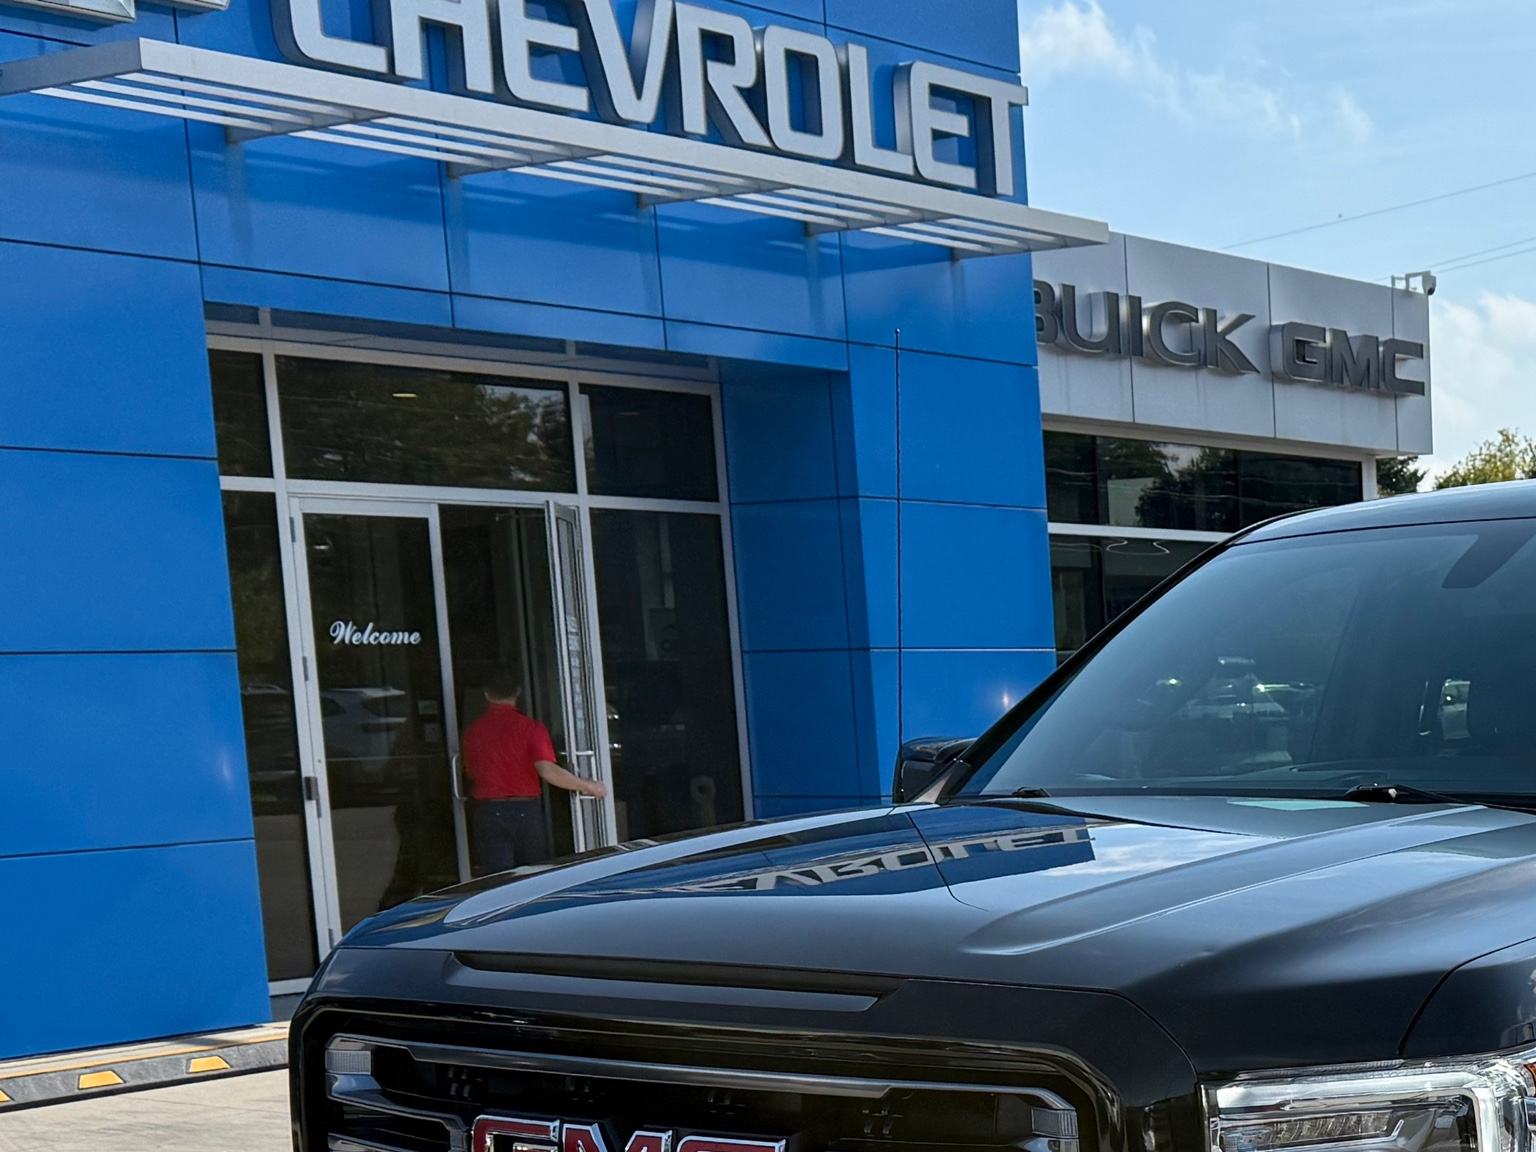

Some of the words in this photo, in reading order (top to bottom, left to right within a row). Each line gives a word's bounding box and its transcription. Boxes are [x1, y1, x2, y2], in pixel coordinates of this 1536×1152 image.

[1033, 279, 1260, 375] BUICK
[1276, 321, 1425, 397] GMC
[329, 620, 421, 645] Welcome
